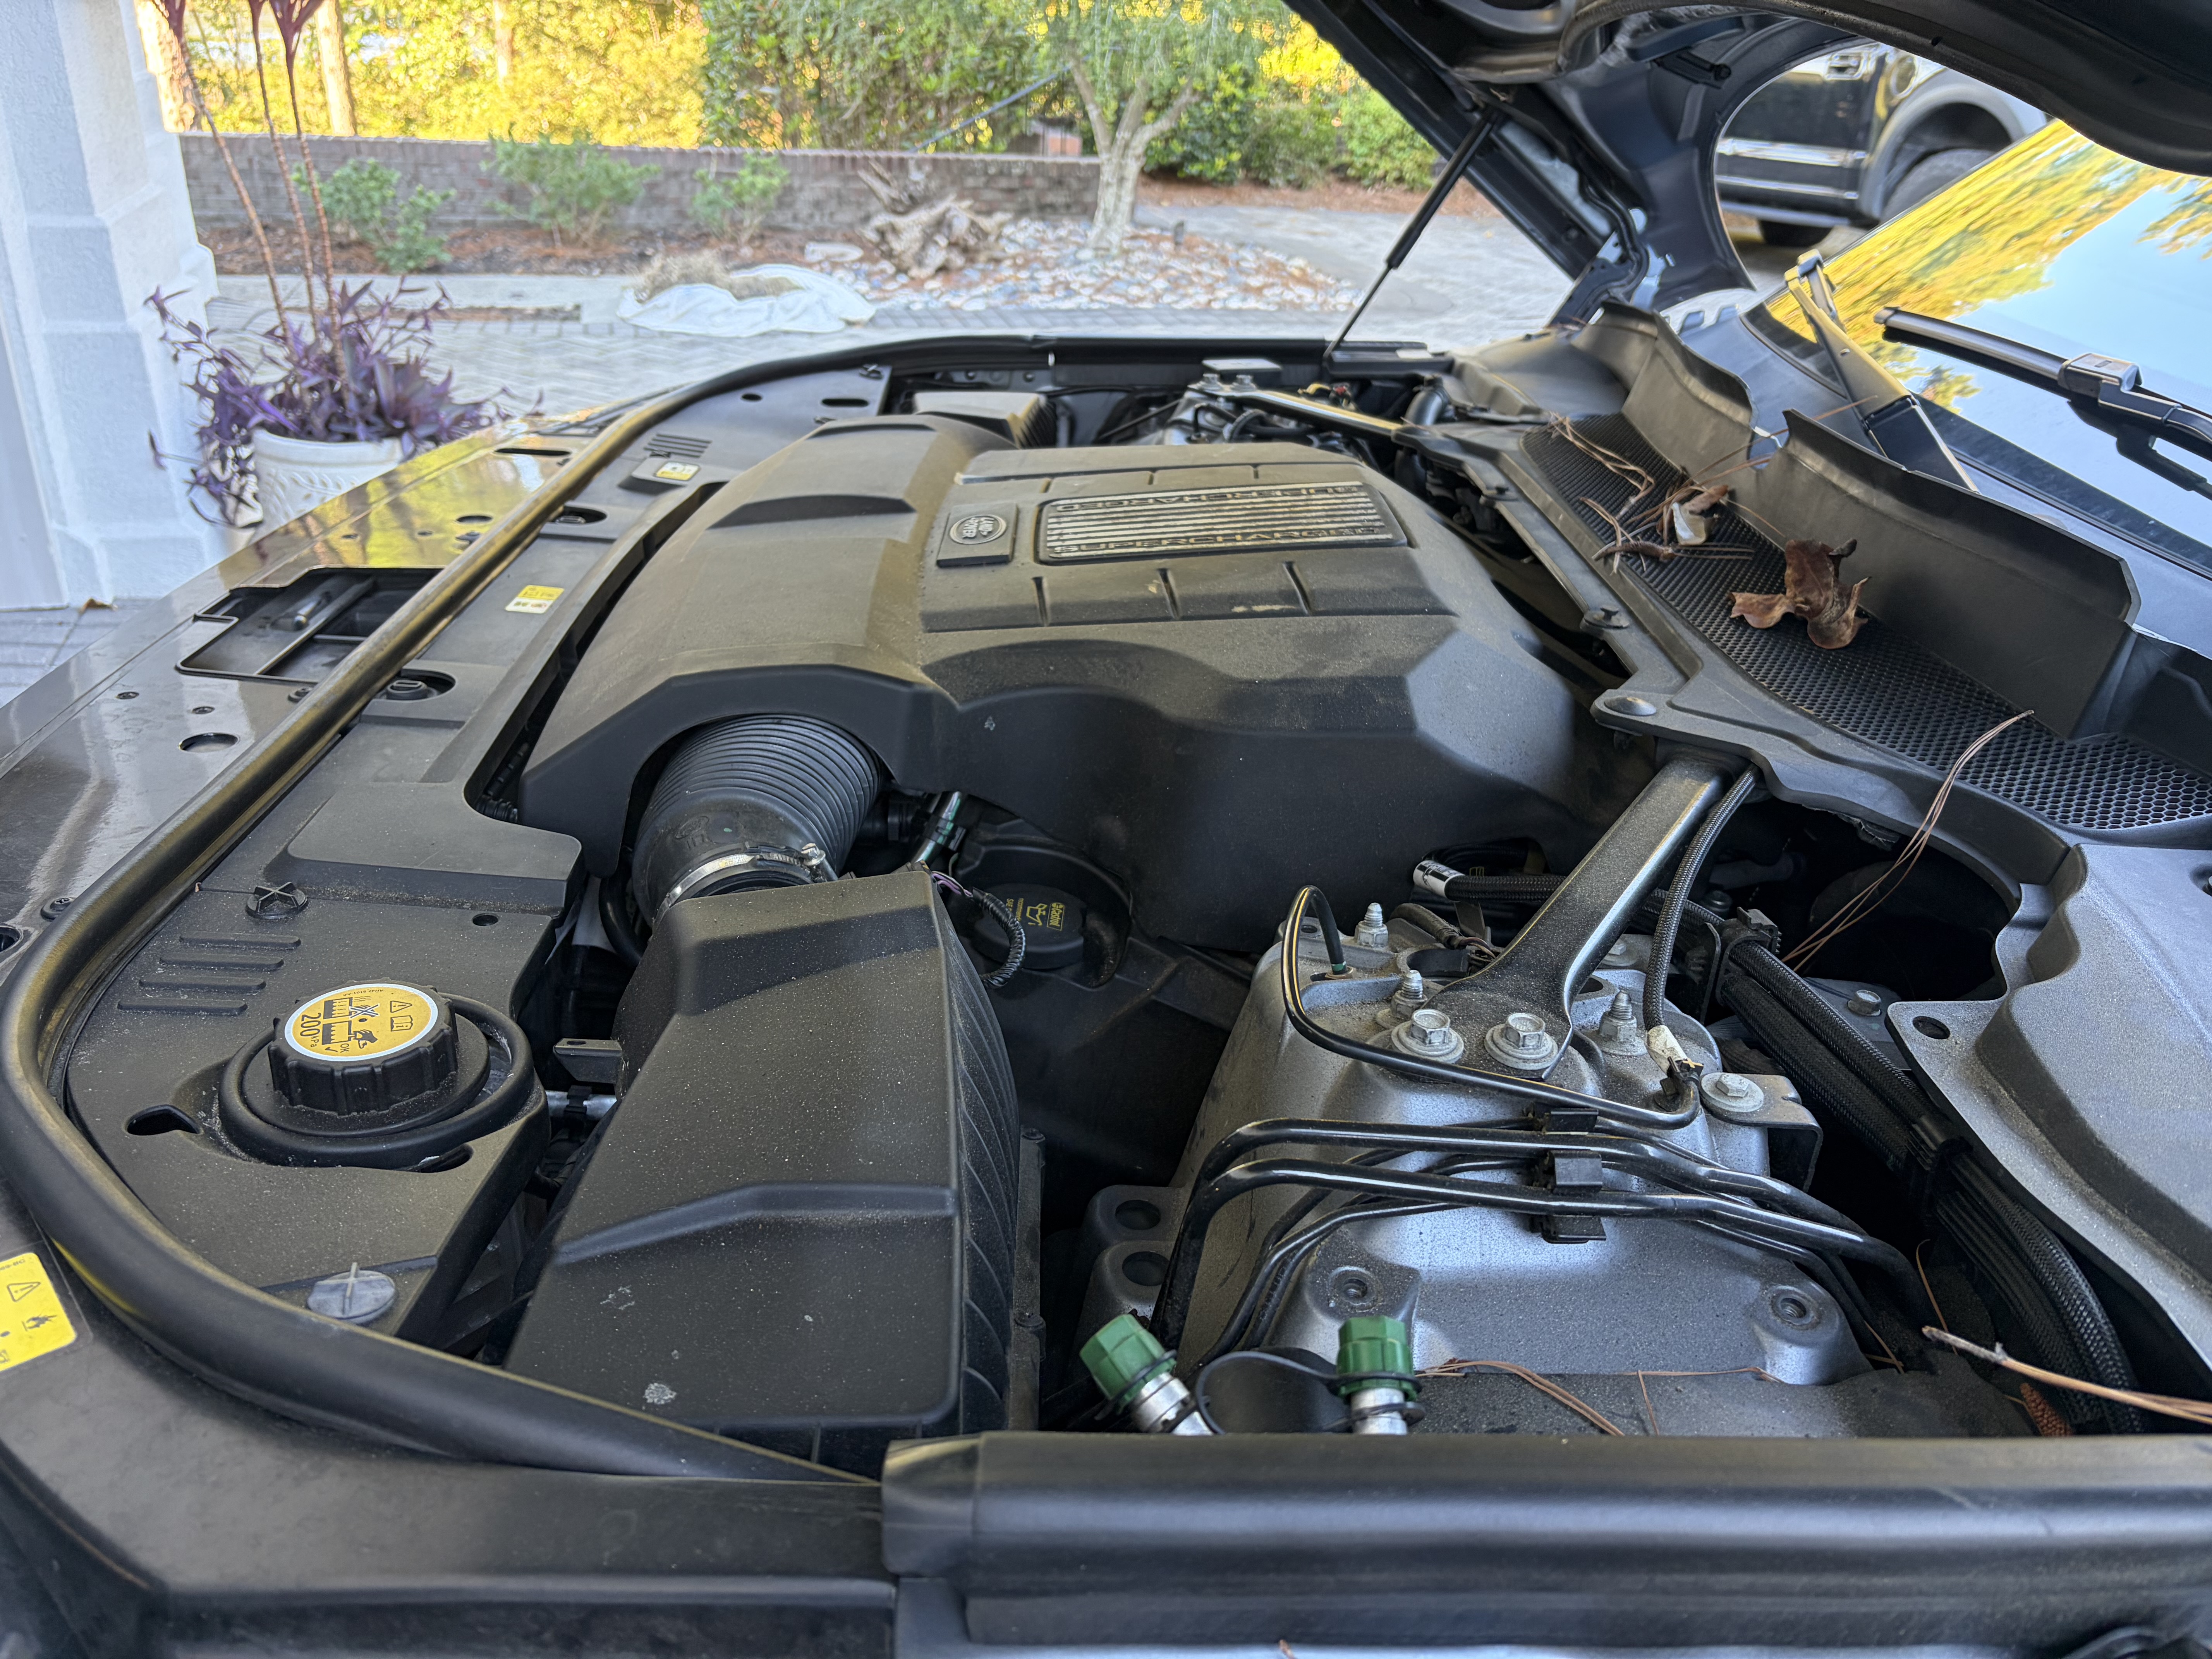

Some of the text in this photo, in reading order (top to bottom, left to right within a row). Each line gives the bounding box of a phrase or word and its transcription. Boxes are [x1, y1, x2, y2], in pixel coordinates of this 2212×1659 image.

[1056, 486, 1358, 512] SUPERCHARGED
[962, 519, 979, 538] ROVER
[979, 517, 994, 532] LAND
[1054, 527, 1380, 553] SUPERCHARGED
[1049, 908, 1062, 927] Castrol
[340, 1043, 350, 1053] OK
